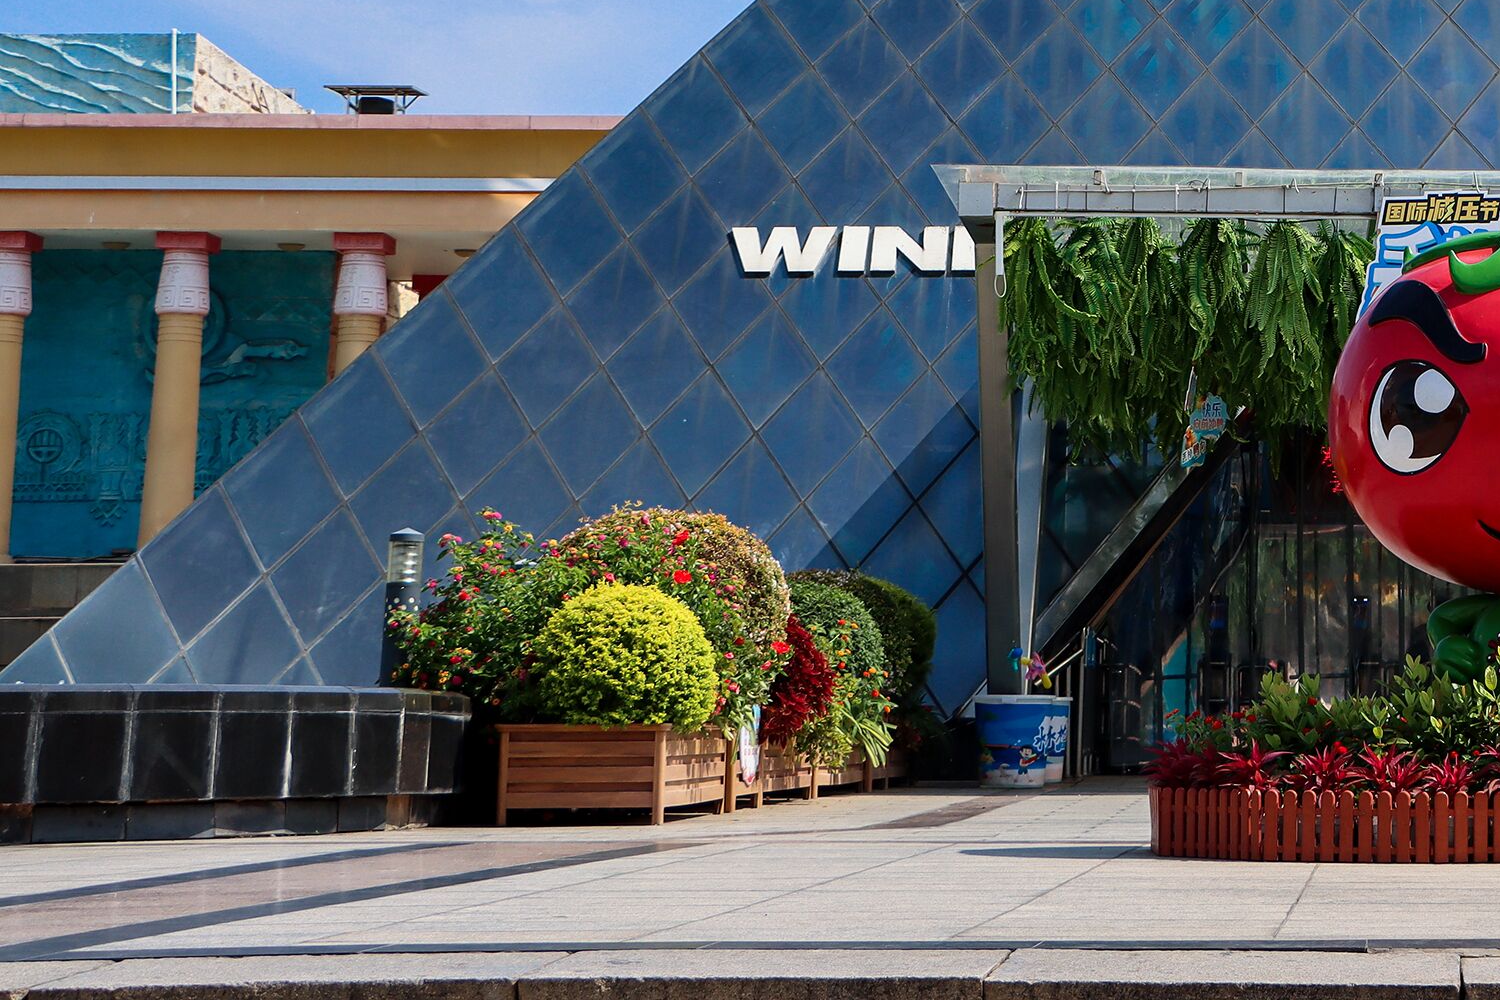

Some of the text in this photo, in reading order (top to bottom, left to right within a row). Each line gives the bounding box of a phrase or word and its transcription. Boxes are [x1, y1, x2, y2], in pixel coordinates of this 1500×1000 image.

[1385, 193, 1500, 223] 国际减压节
[731, 225, 976, 273] WIN
